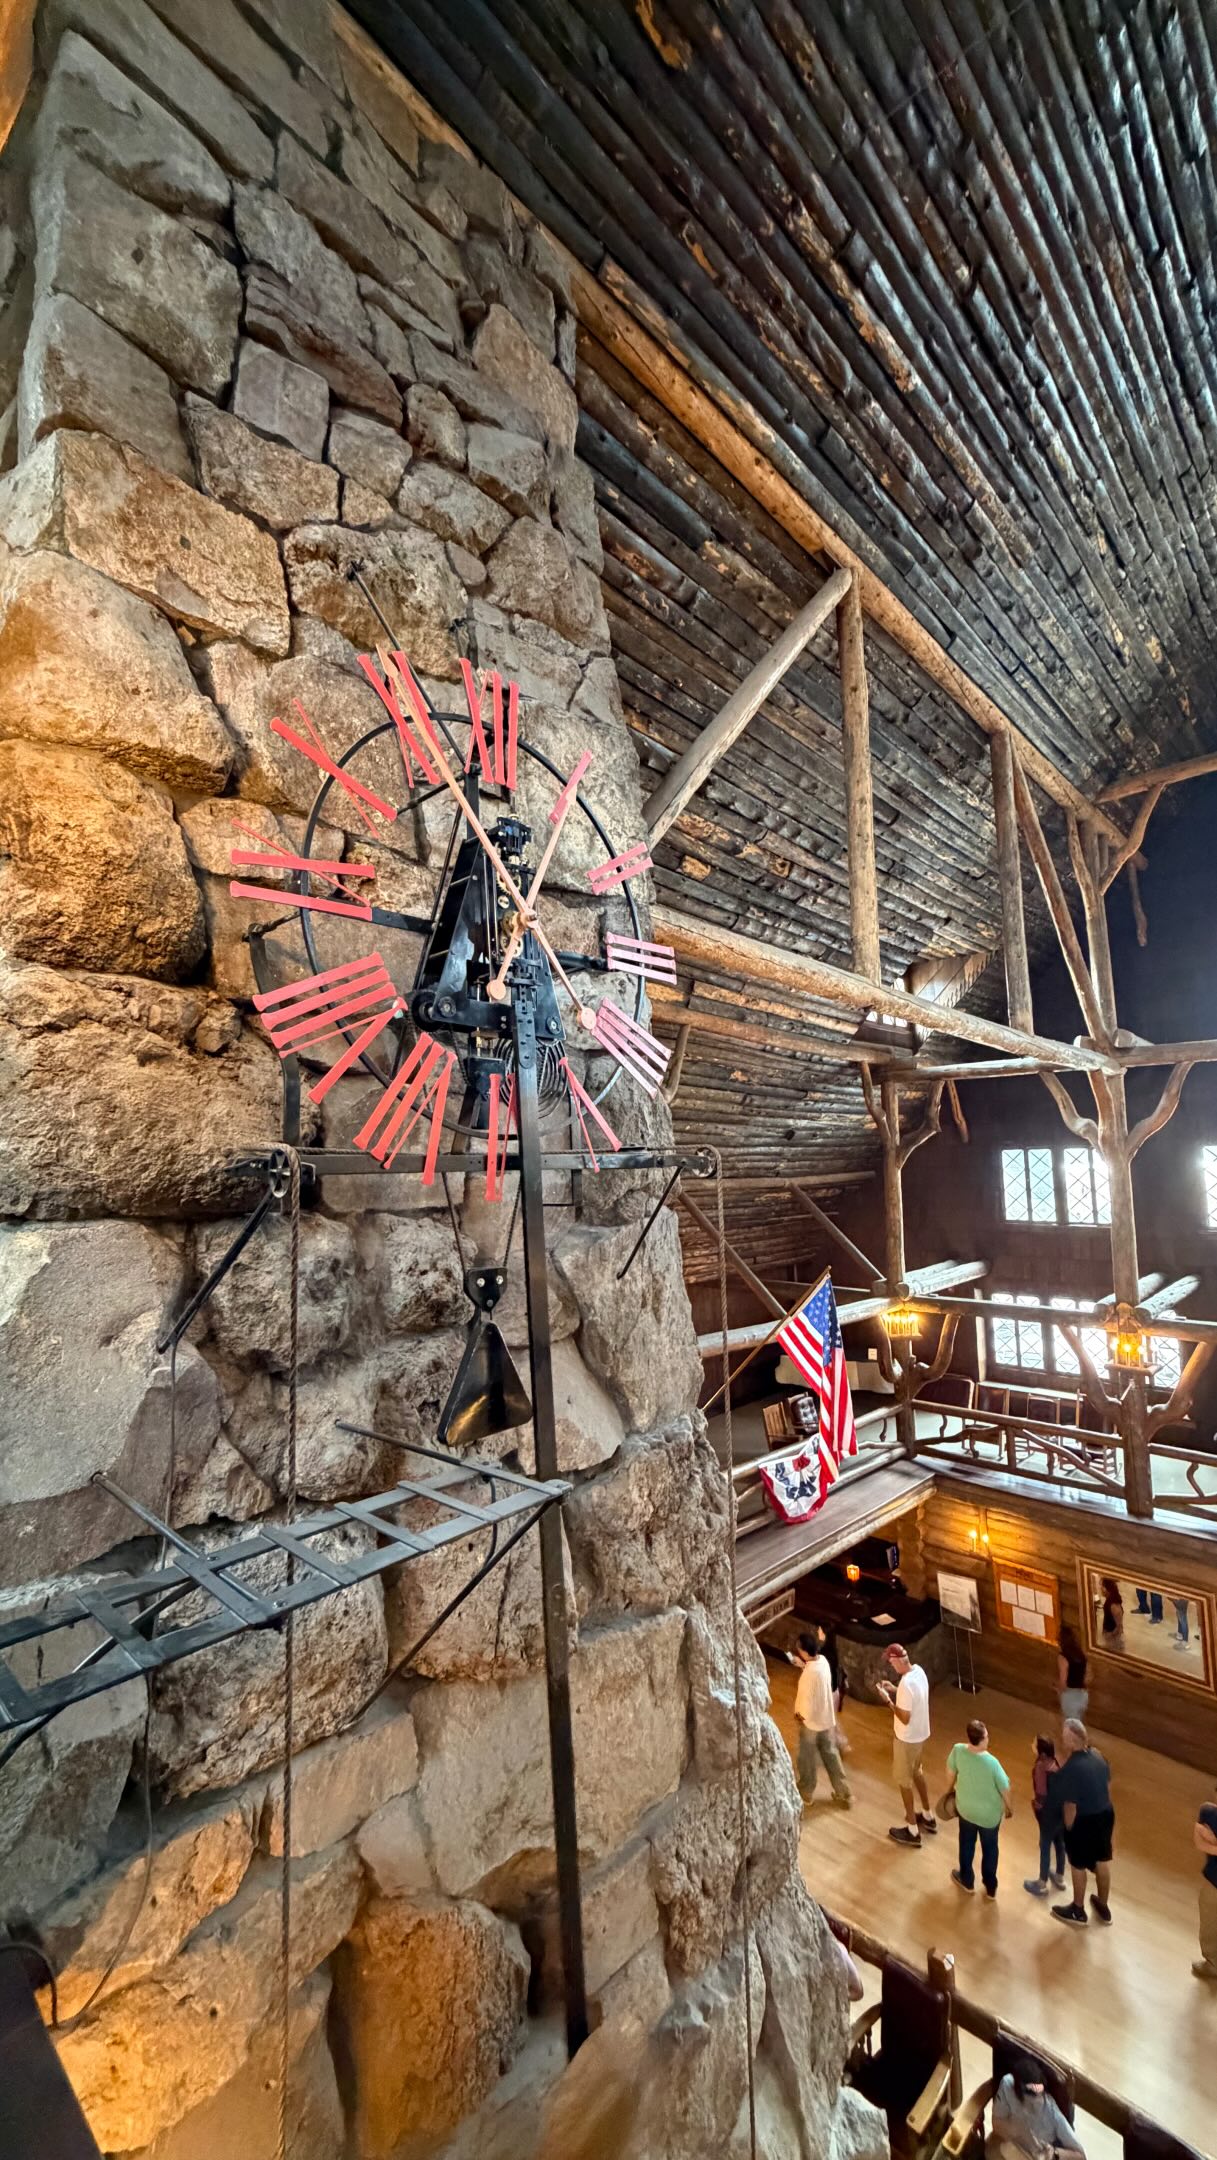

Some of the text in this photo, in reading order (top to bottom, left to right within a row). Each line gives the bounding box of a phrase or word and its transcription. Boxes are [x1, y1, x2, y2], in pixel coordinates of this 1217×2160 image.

[270, 698, 398, 839] X
[357, 651, 446, 788] XI
[459, 658, 520, 791] XII
